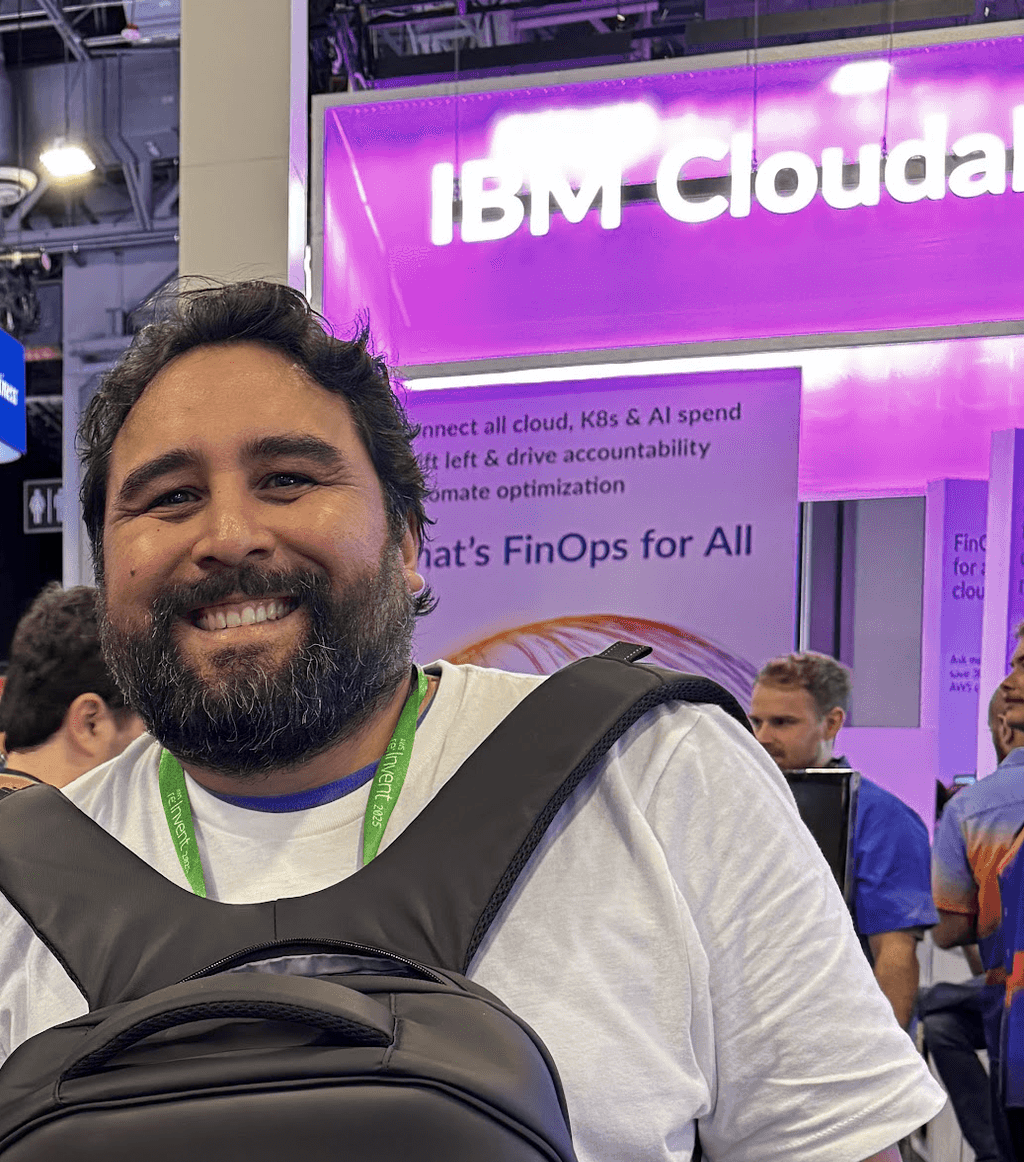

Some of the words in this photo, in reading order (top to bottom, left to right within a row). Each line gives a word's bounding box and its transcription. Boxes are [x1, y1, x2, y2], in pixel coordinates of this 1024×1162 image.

[431, 148, 622, 246] IBM
[656, 104, 1024, 223] Clouda
[421, 420, 478, 439] nnect
[484, 416, 506, 435] all
[512, 412, 574, 435] cloud,
[580, 409, 619, 430] K8s
[625, 407, 641, 426] &
[648, 405, 672, 426] AI
[677, 402, 742, 427] spend
[445, 450, 477, 470] left
[484, 449, 500, 467] &
[506, 444, 558, 467] drive
[562, 438, 712, 464] accountability
[430, 483, 491, 503] omate
[496, 475, 626, 503] optimization
[503, 532, 628, 569] FinOps
[641, 528, 694, 560] for
[703, 524, 753, 558] All
[953, 557, 976, 576] for
